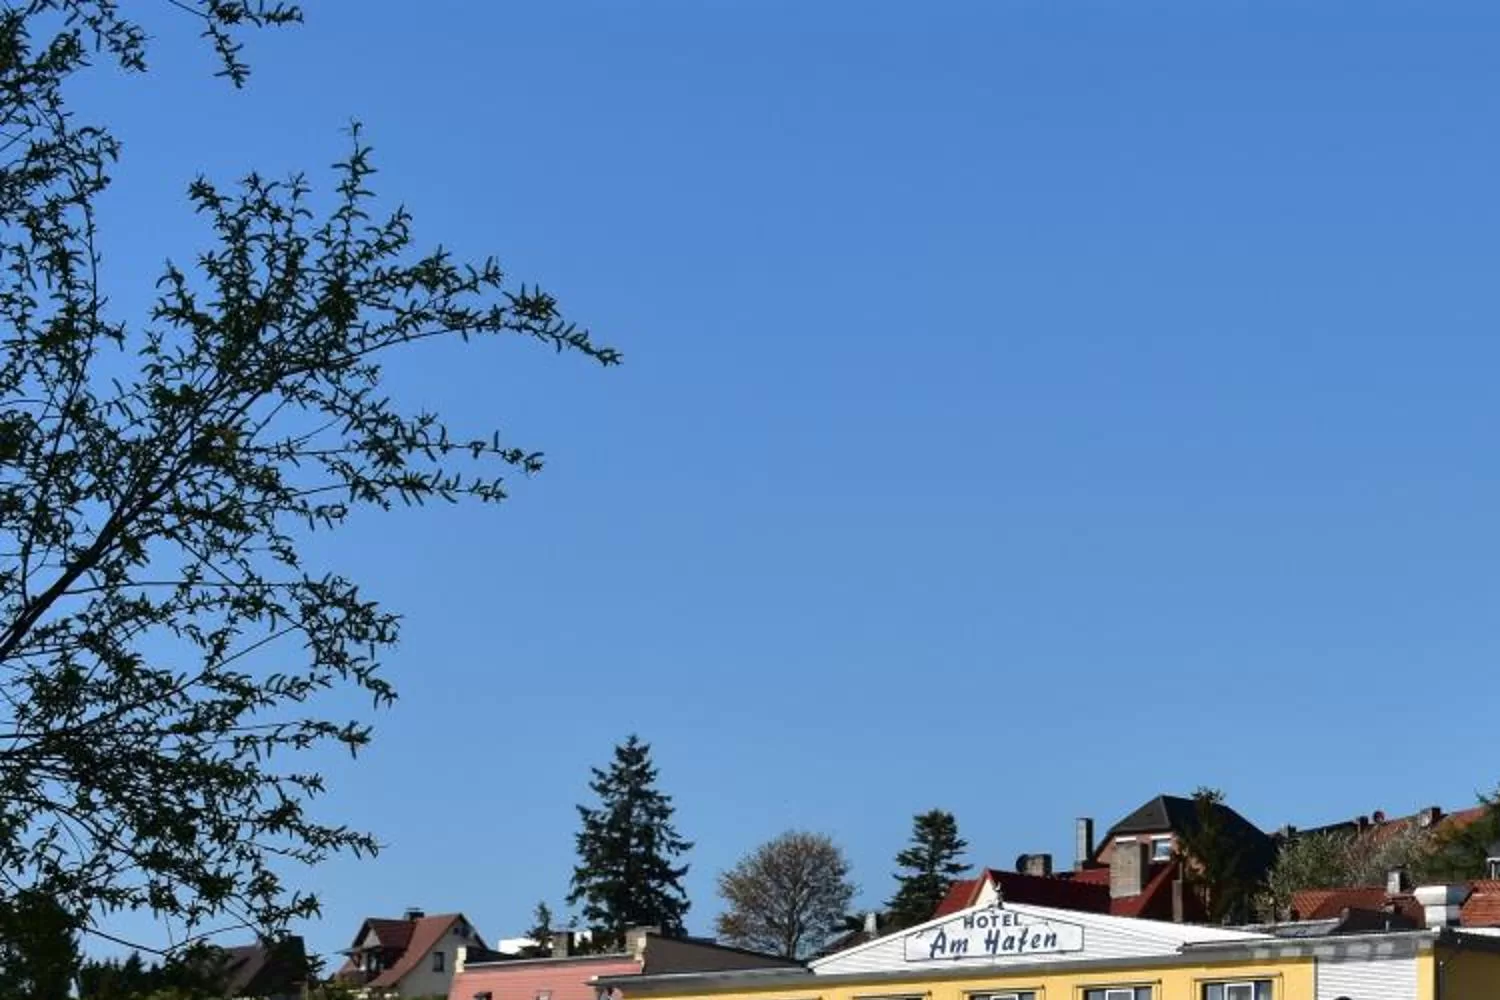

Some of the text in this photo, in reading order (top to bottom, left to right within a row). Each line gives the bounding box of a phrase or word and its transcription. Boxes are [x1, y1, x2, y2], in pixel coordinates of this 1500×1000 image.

[963, 914, 1020, 928] HOTEL
[930, 928, 1057, 958] Am Hafen
